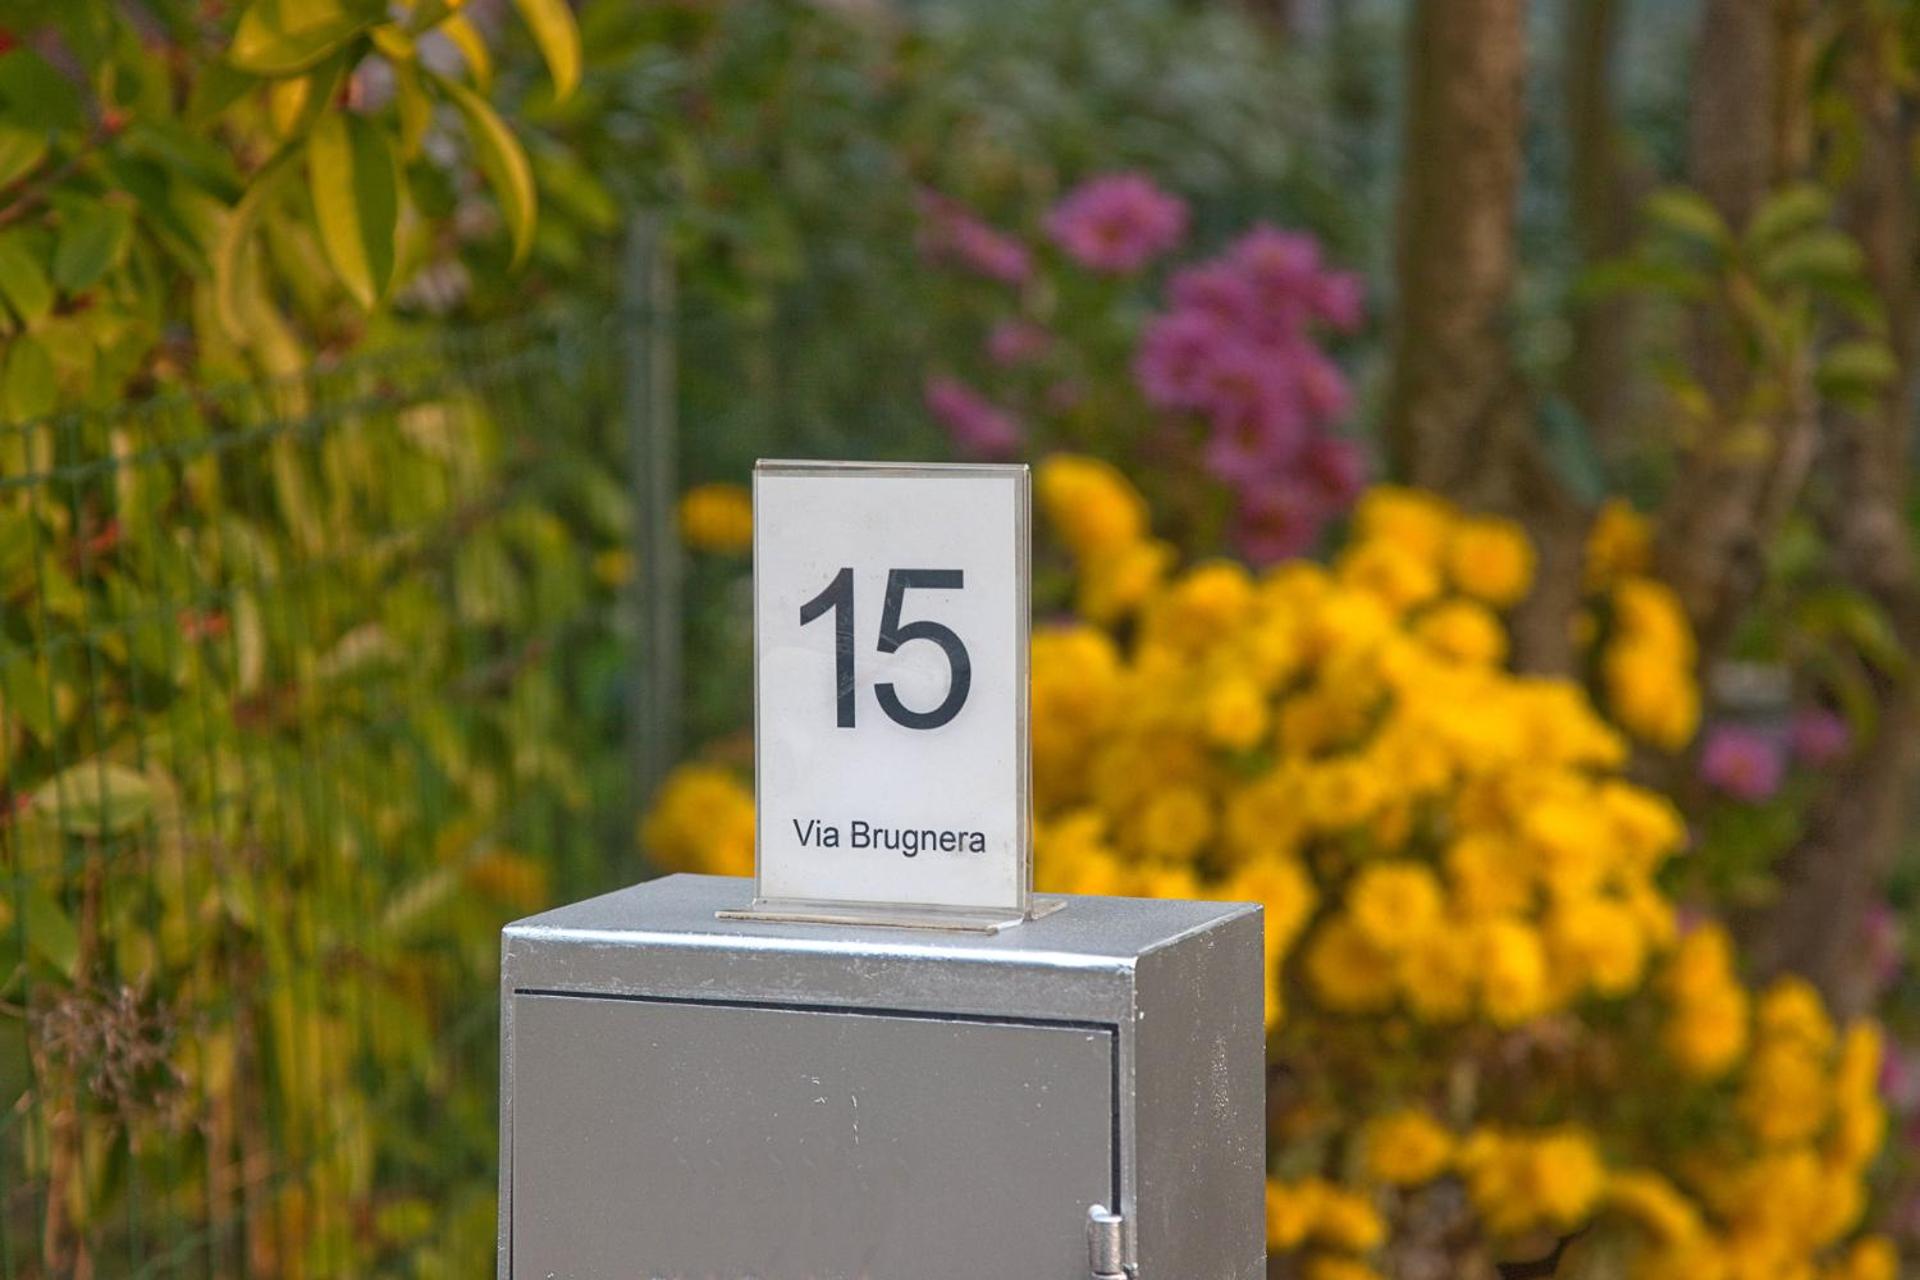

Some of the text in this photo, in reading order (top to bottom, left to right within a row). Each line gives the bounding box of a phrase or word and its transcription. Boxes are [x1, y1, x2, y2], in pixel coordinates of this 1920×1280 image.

[800, 567, 971, 730] 15
[793, 819, 986, 858] Via Brugnera
